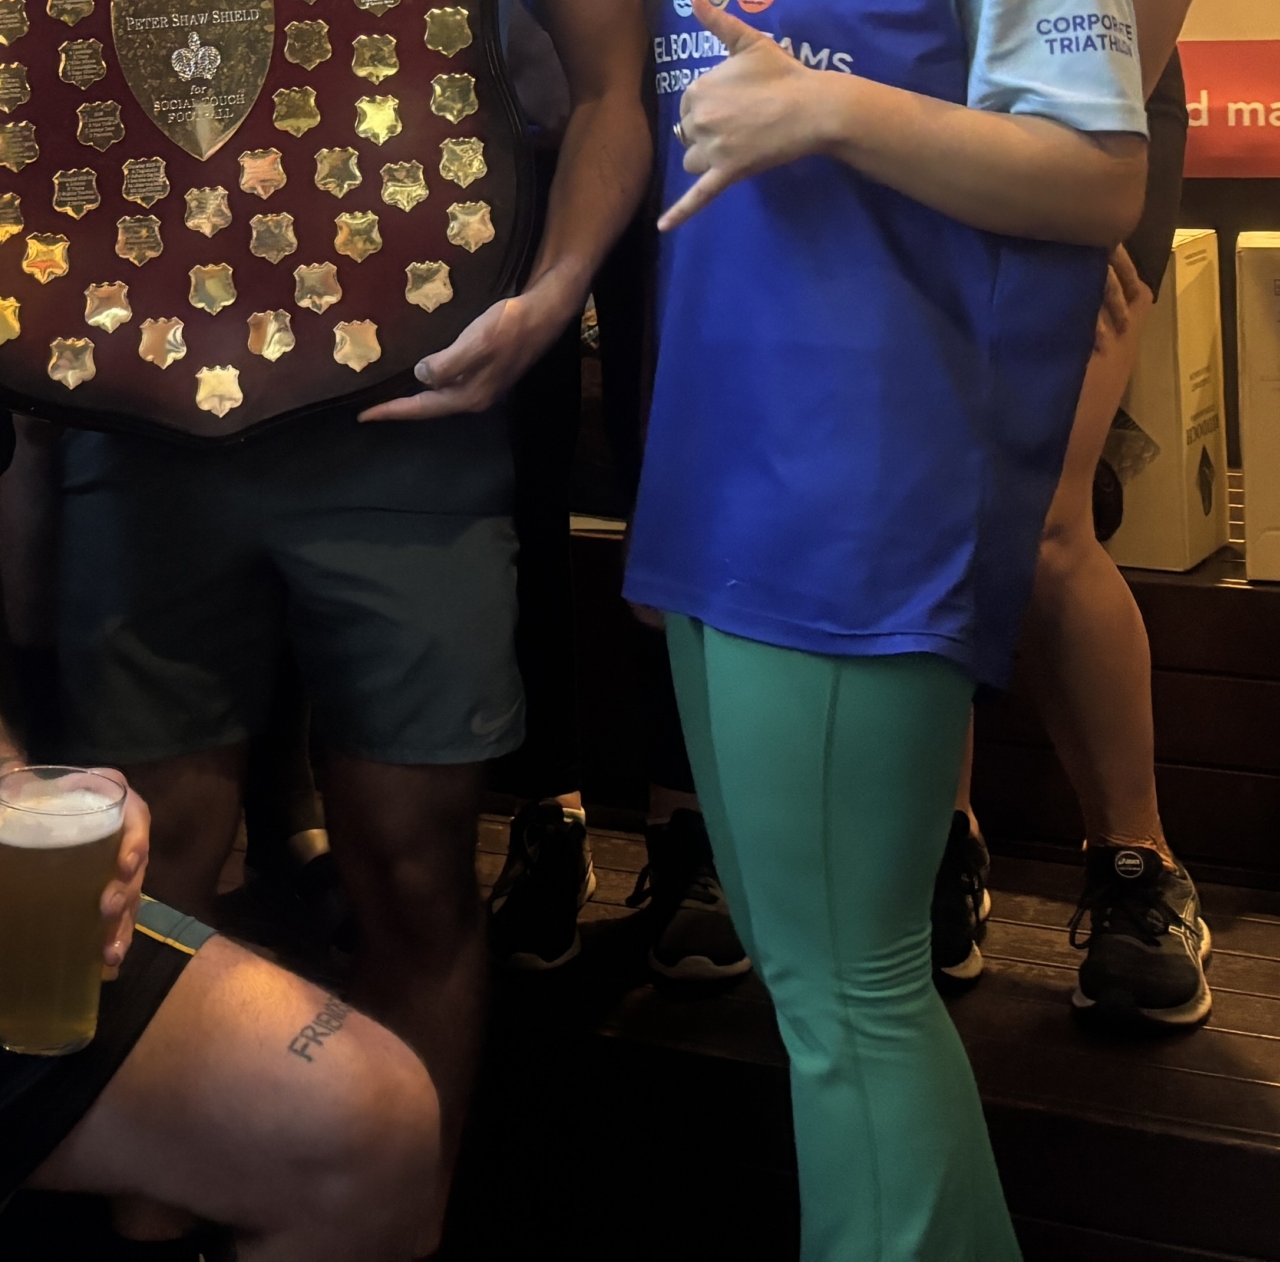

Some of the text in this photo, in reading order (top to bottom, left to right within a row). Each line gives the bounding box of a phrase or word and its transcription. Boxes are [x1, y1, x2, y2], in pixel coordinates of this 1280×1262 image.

[126, 8, 260, 31] PETER SHAW SHIELD
[1036, 13, 1132, 41] CORPOTE
[1045, 34, 1133, 57] TRIATH
[190, 84, 207, 95] for
[167, 108, 234, 124] FOOLL
